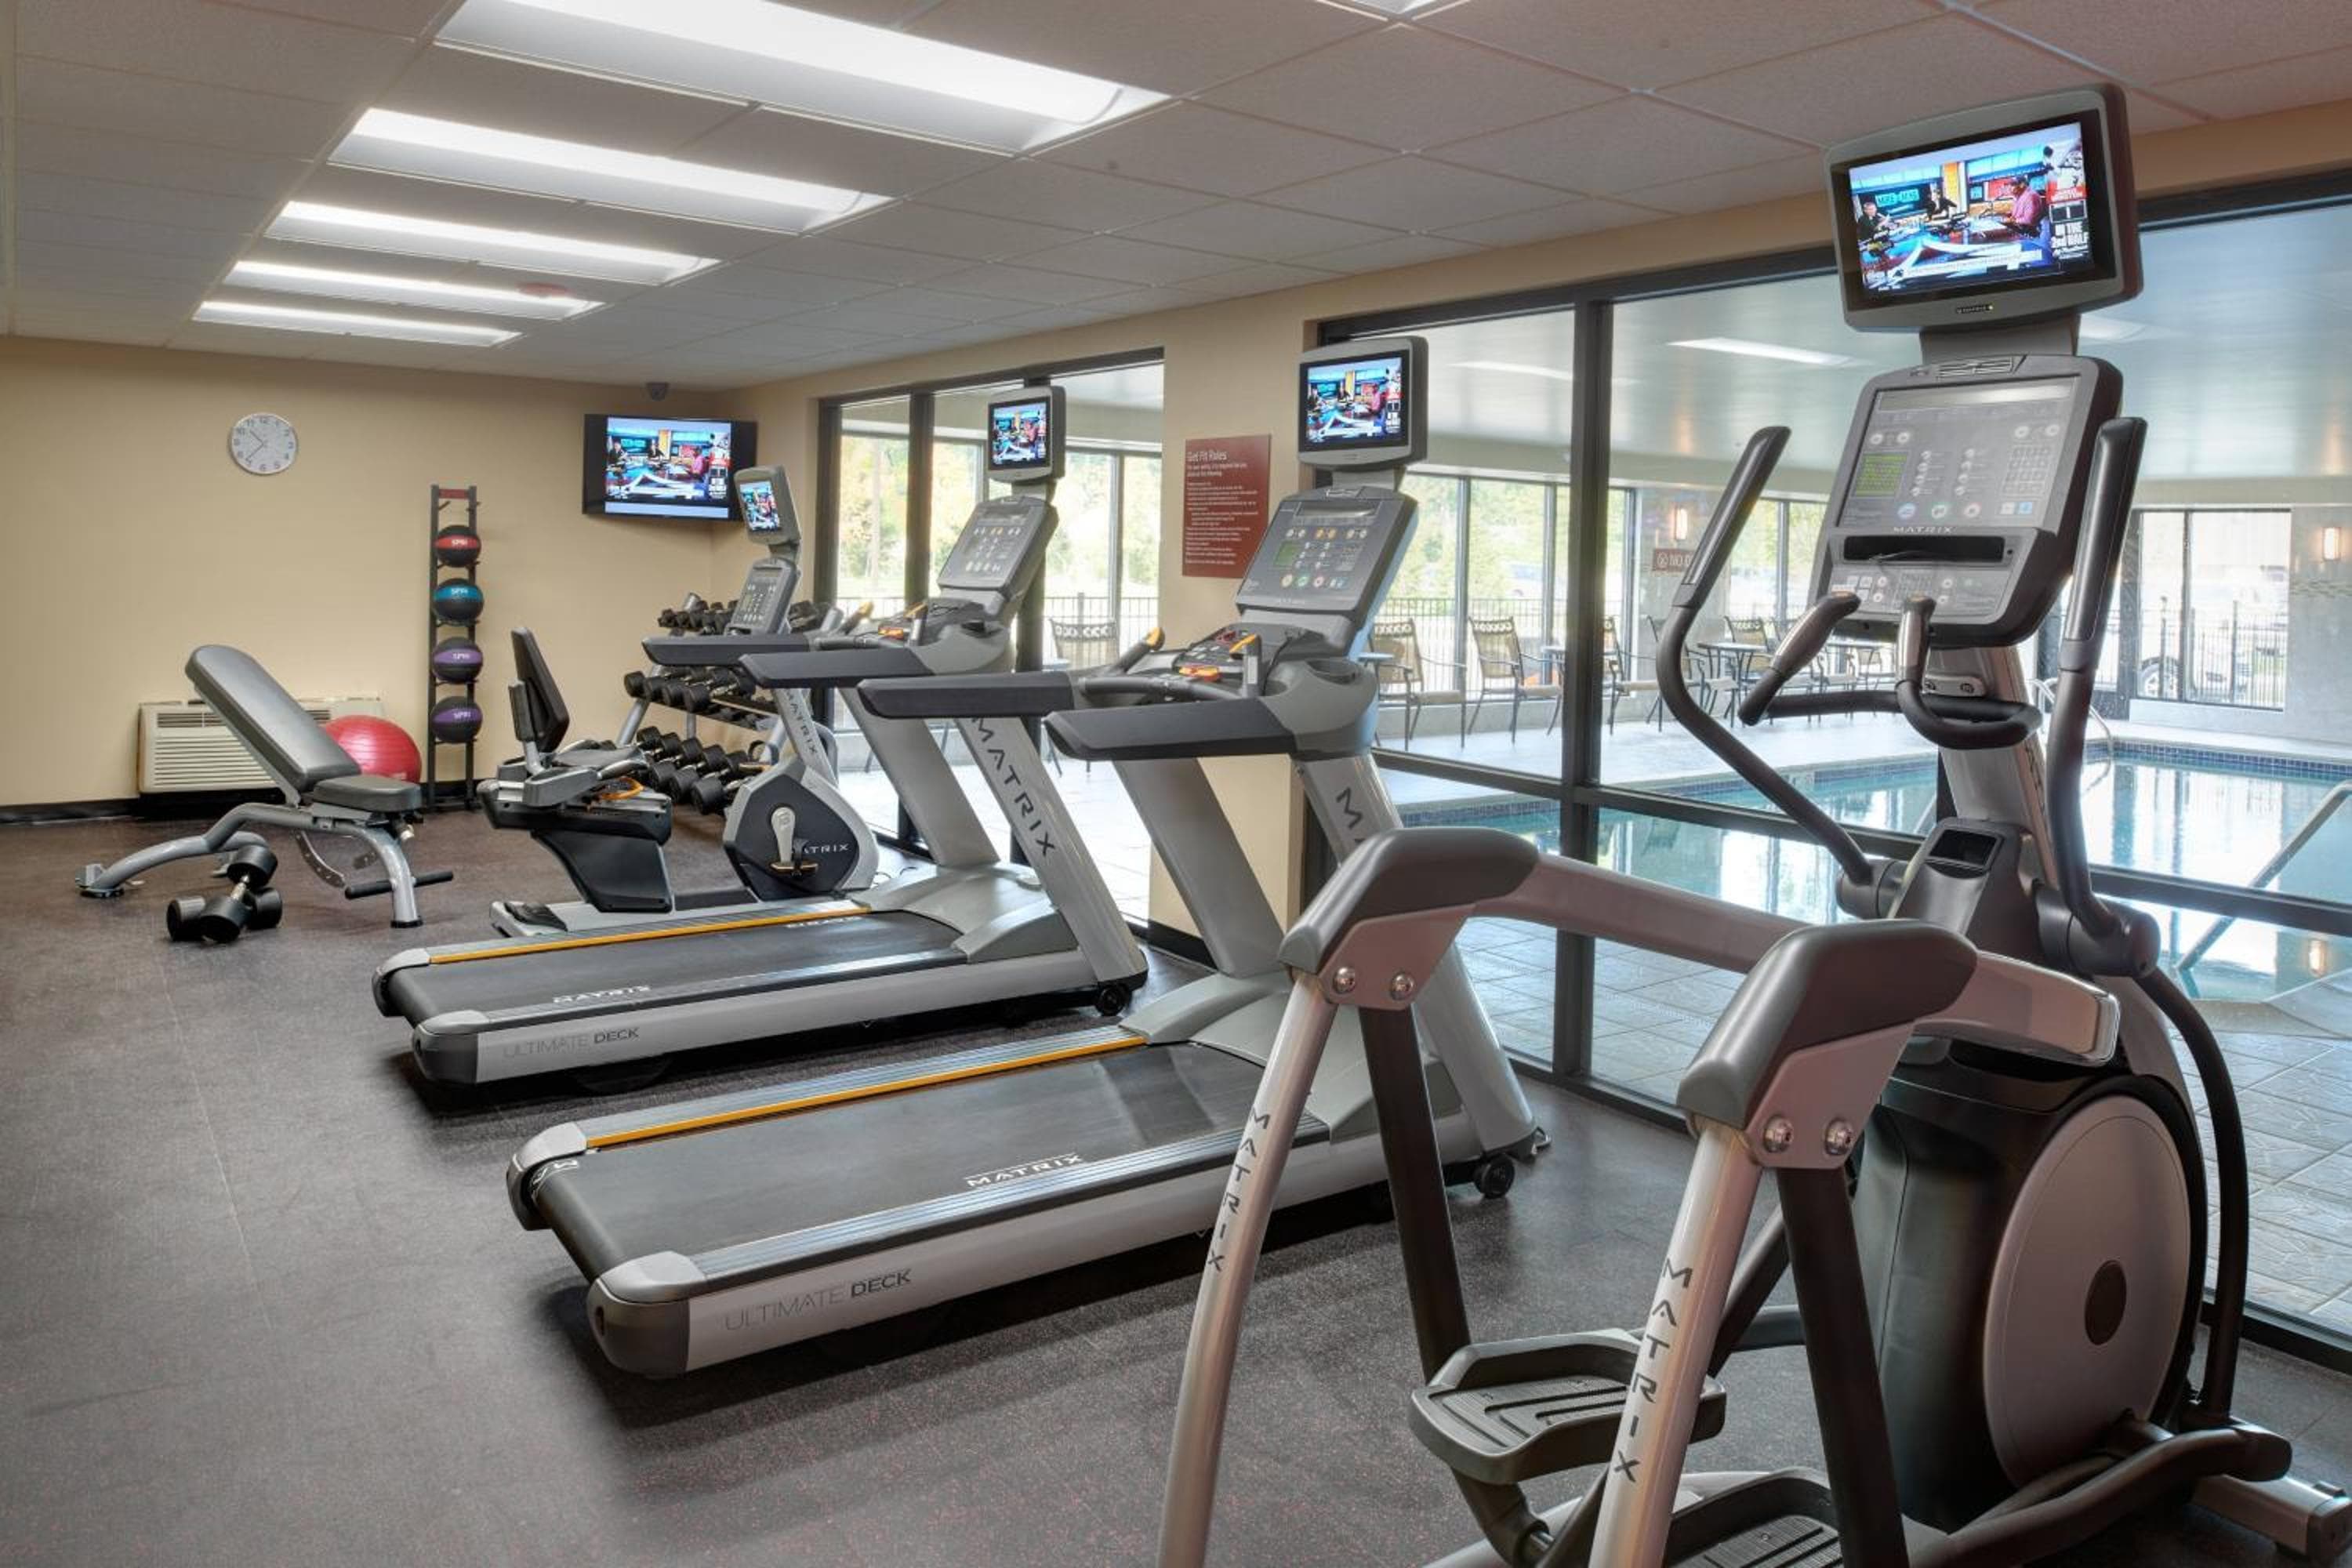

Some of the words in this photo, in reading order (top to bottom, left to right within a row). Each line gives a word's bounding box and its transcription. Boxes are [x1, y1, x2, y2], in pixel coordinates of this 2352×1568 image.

[971, 717, 1056, 857] MATRIX
[503, 1034, 588, 1058] ULTIMATE
[593, 1027, 640, 1044] DECK
[967, 1154, 1083, 1187] MATRIX
[1207, 1107, 1271, 1272] MATRIX
[725, 1282, 847, 1331] ULTIMATE
[851, 1268, 912, 1298] DECK
[1613, 1257, 1693, 1483] MATRIX
